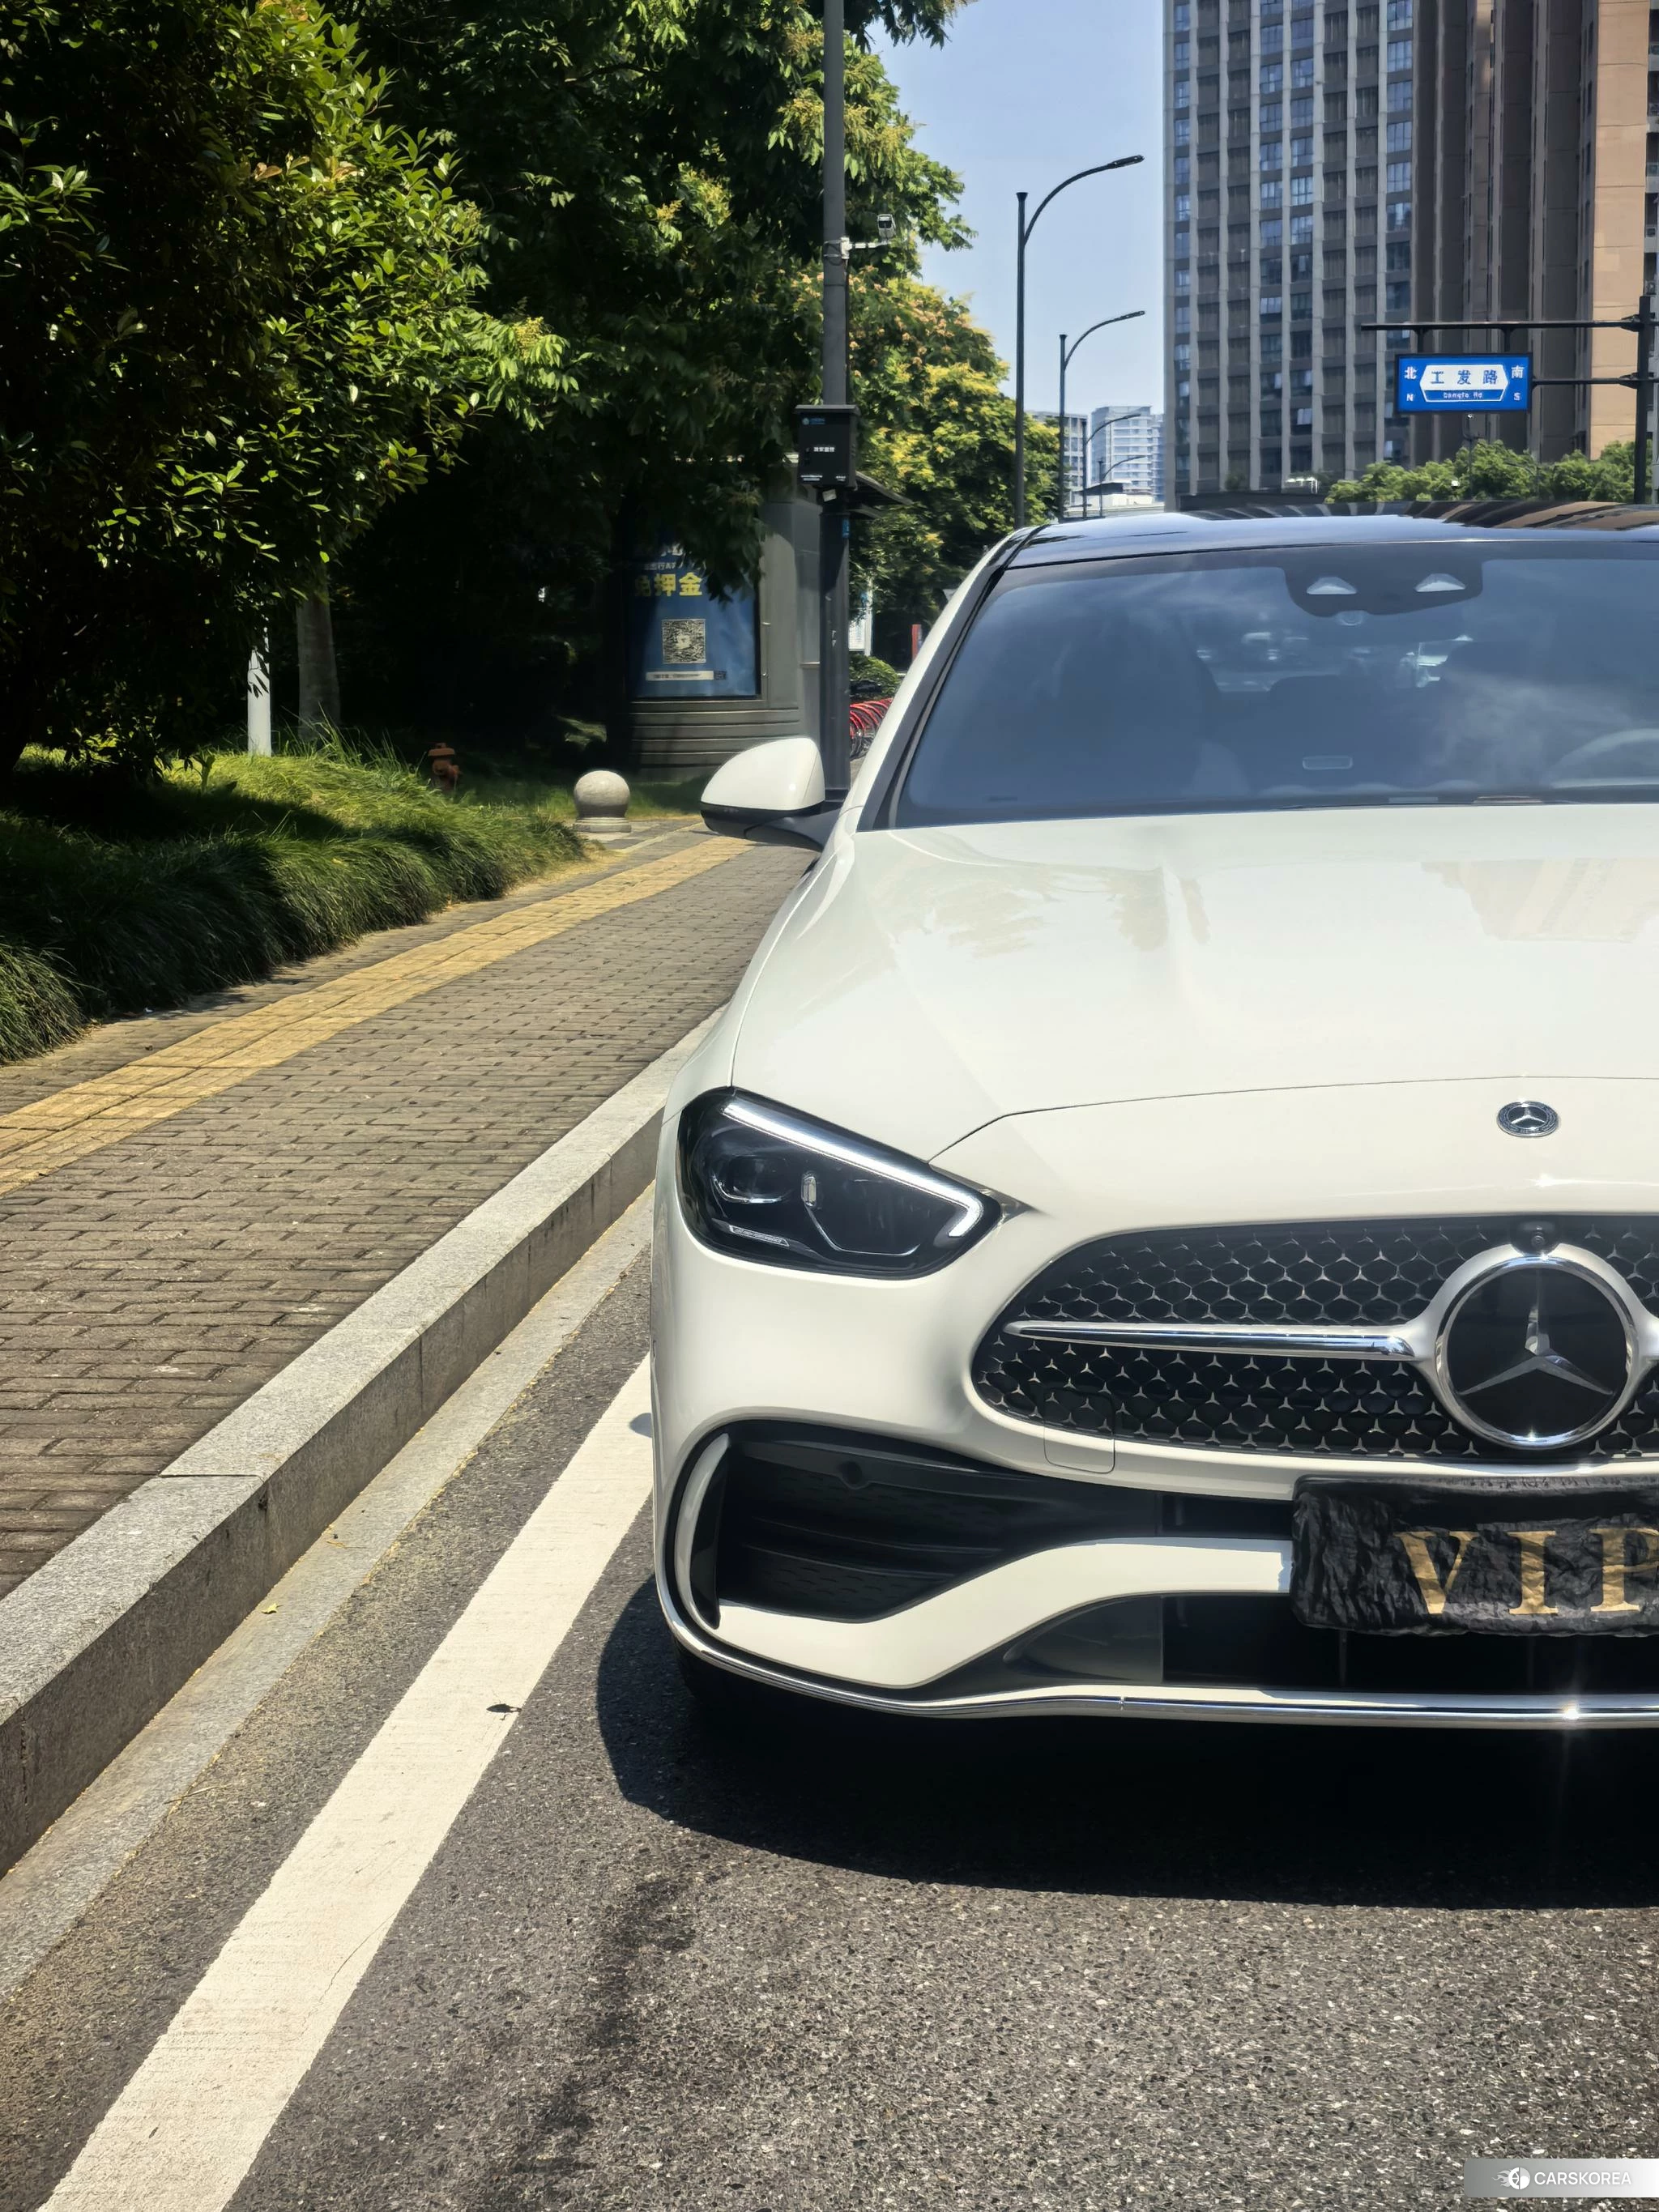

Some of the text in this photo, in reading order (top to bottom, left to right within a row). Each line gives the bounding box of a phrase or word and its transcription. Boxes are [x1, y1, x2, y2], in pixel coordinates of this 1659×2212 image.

[1404, 366, 1417, 379] 北
[1430, 370, 1498, 385] 工发路
[1511, 365, 1525, 378] 南
[1406, 393, 1414, 401] N
[1513, 392, 1521, 401] S
[1392, 1526, 1659, 1615] VIP
